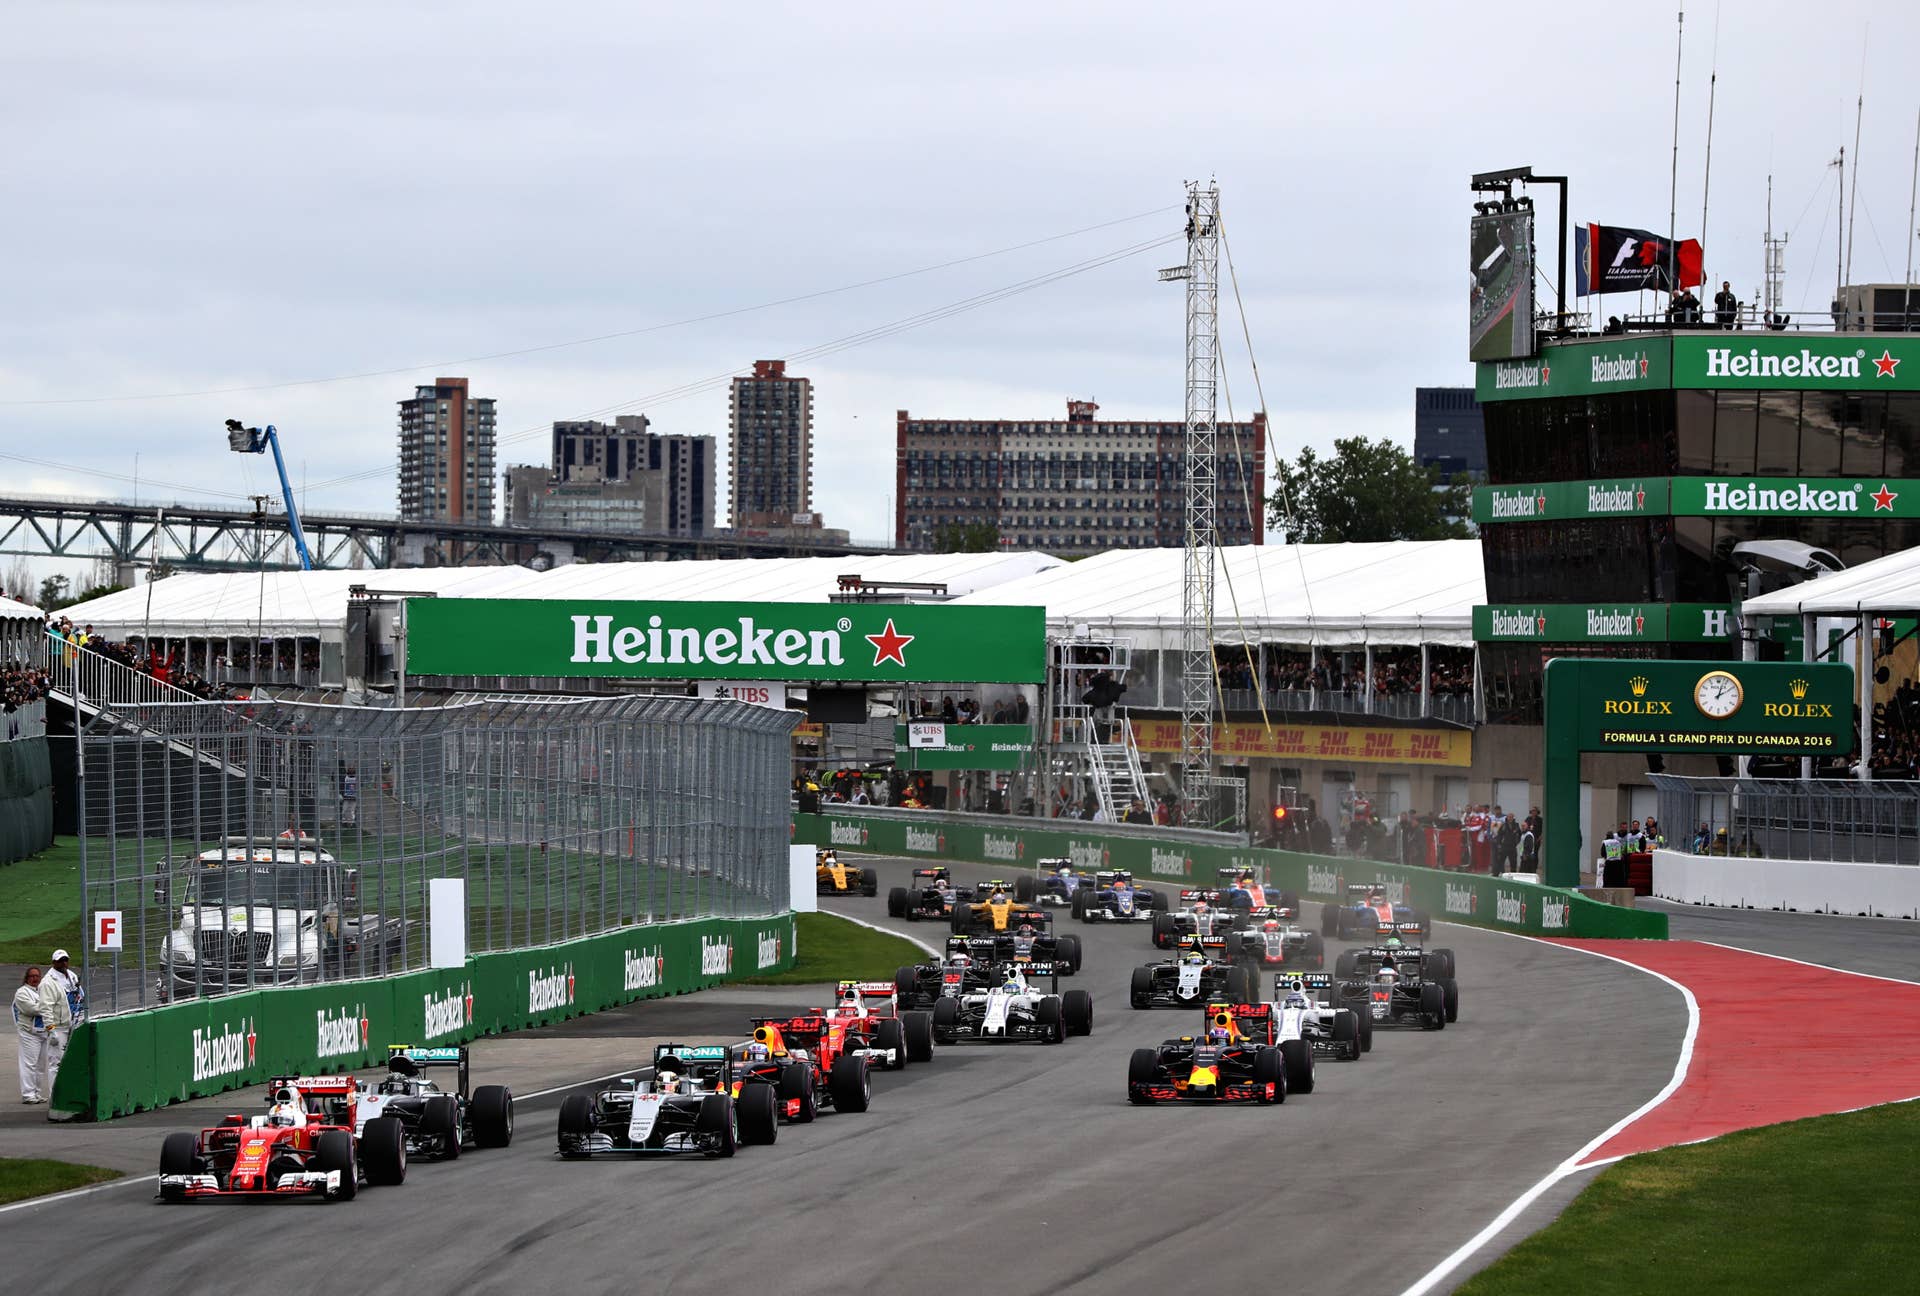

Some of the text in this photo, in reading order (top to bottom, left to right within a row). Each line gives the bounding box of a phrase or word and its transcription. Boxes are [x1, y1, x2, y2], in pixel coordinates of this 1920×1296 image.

[1496, 362, 1538, 389] Heineken
[1592, 353, 1636, 382] Heineken
[1706, 349, 1860, 378] Heineken
[1492, 492, 1535, 518] Heineken
[1588, 486, 1633, 512] Heineken
[1705, 482, 1859, 511] Heineken
[1492, 610, 1535, 636] Heineken
[1587, 609, 1633, 636] Heineken
[570, 615, 844, 665] Heineken
[733, 687, 768, 702] UBS
[1604, 700, 1673, 715] ROLEX
[1764, 703, 1833, 717] ROLEX
[922, 726, 942, 735] UBS
[1604, 733, 1832, 746] FORMULA 1 GRAND PRIX DU CANADA 2016
[100, 917, 116, 945] F
[624, 947, 656, 991] Heineken
[944, 974, 960, 982] 22
[529, 966, 566, 1013] Heineken
[1373, 992, 1389, 1001] 14
[425, 987, 464, 1040] Heineken
[317, 1006, 359, 1058] Heineken
[193, 1022, 244, 1081] Heineken
